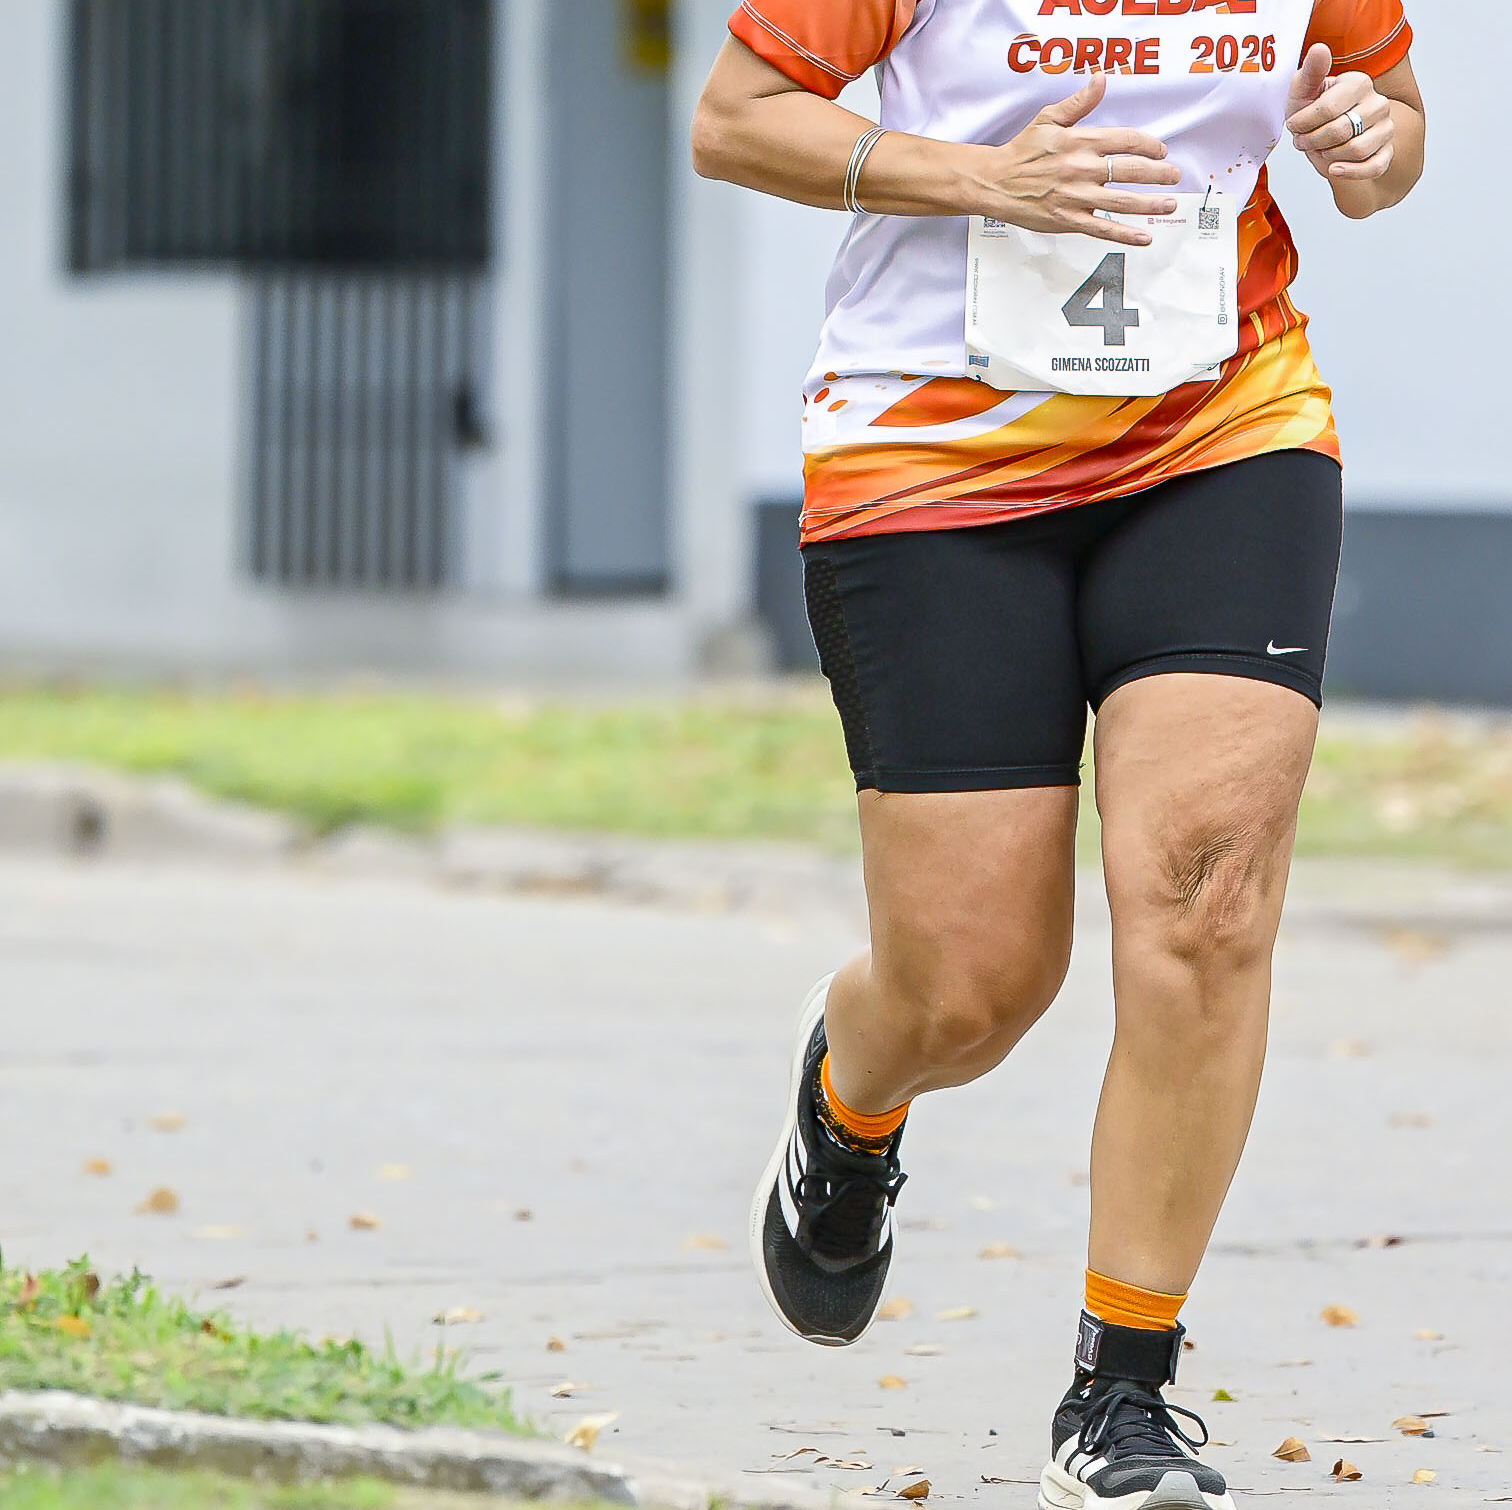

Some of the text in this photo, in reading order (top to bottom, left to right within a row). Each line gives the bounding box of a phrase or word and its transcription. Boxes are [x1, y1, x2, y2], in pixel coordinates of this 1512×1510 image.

[1007, 33, 1276, 75] CORRE 2026
[1061, 252, 1139, 346] 4
[1051, 357, 1150, 372] GIMENA SCOZZATTI
